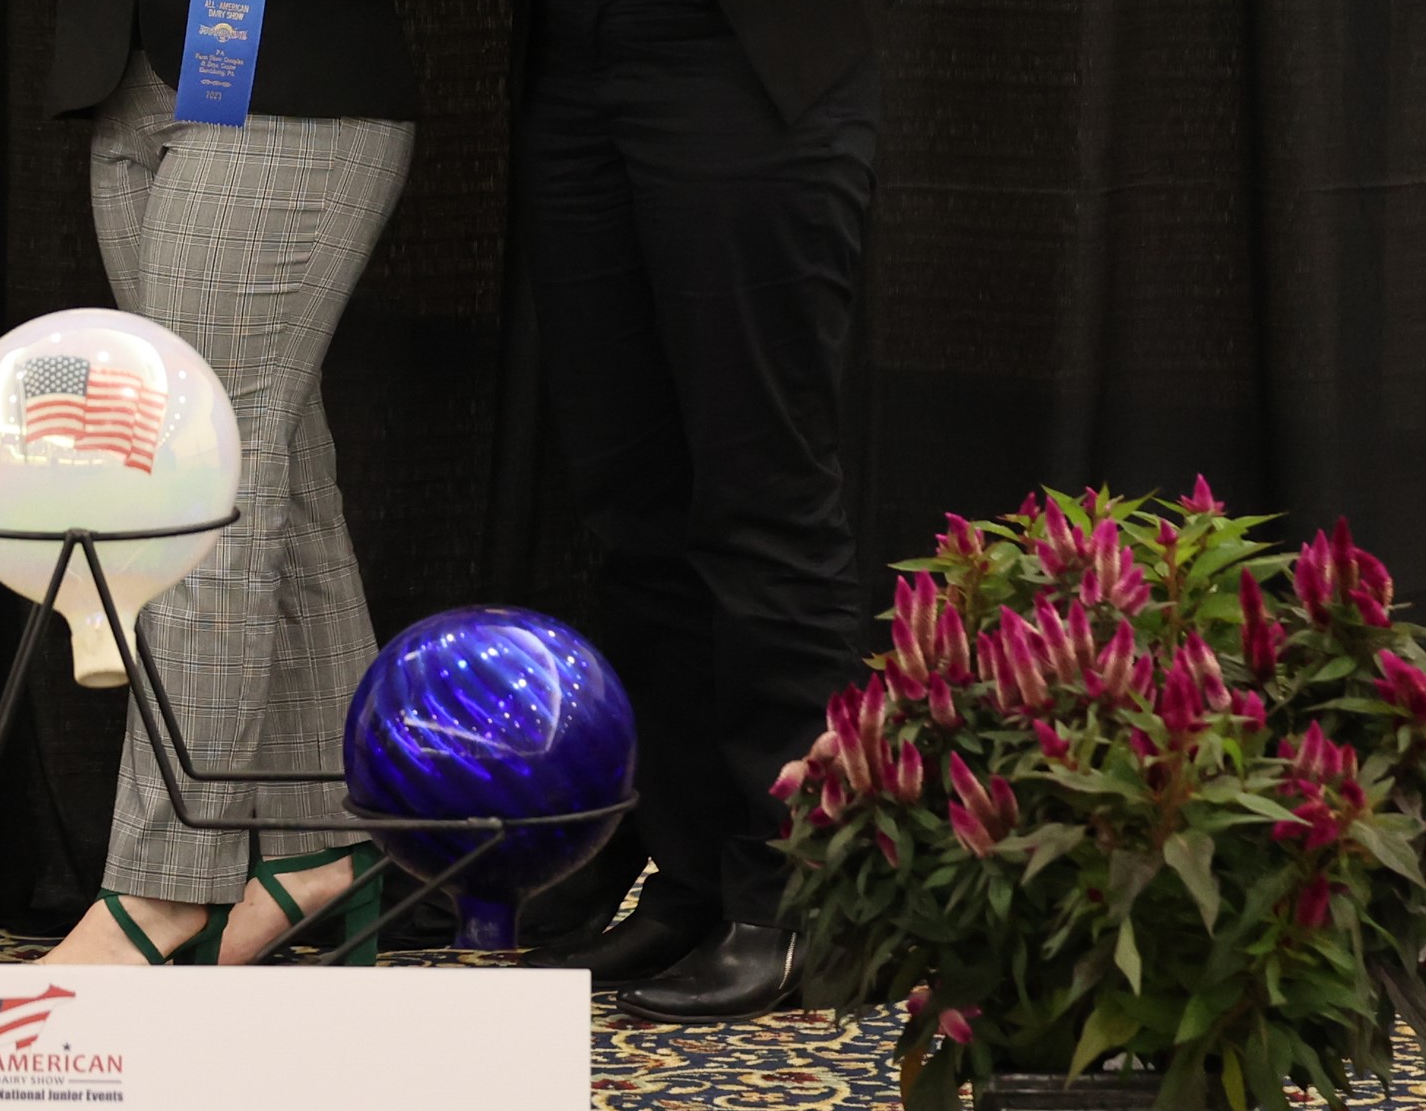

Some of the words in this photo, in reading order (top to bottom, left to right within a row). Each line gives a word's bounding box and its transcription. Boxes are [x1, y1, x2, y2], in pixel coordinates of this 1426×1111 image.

[208, 8, 225, 18] DAIRY
[227, 12, 244, 20] SHOW
[31, 1075, 65, 1085] SHOW
[48, 1089, 82, 1101] Junior
[86, 1090, 123, 1102] Events
